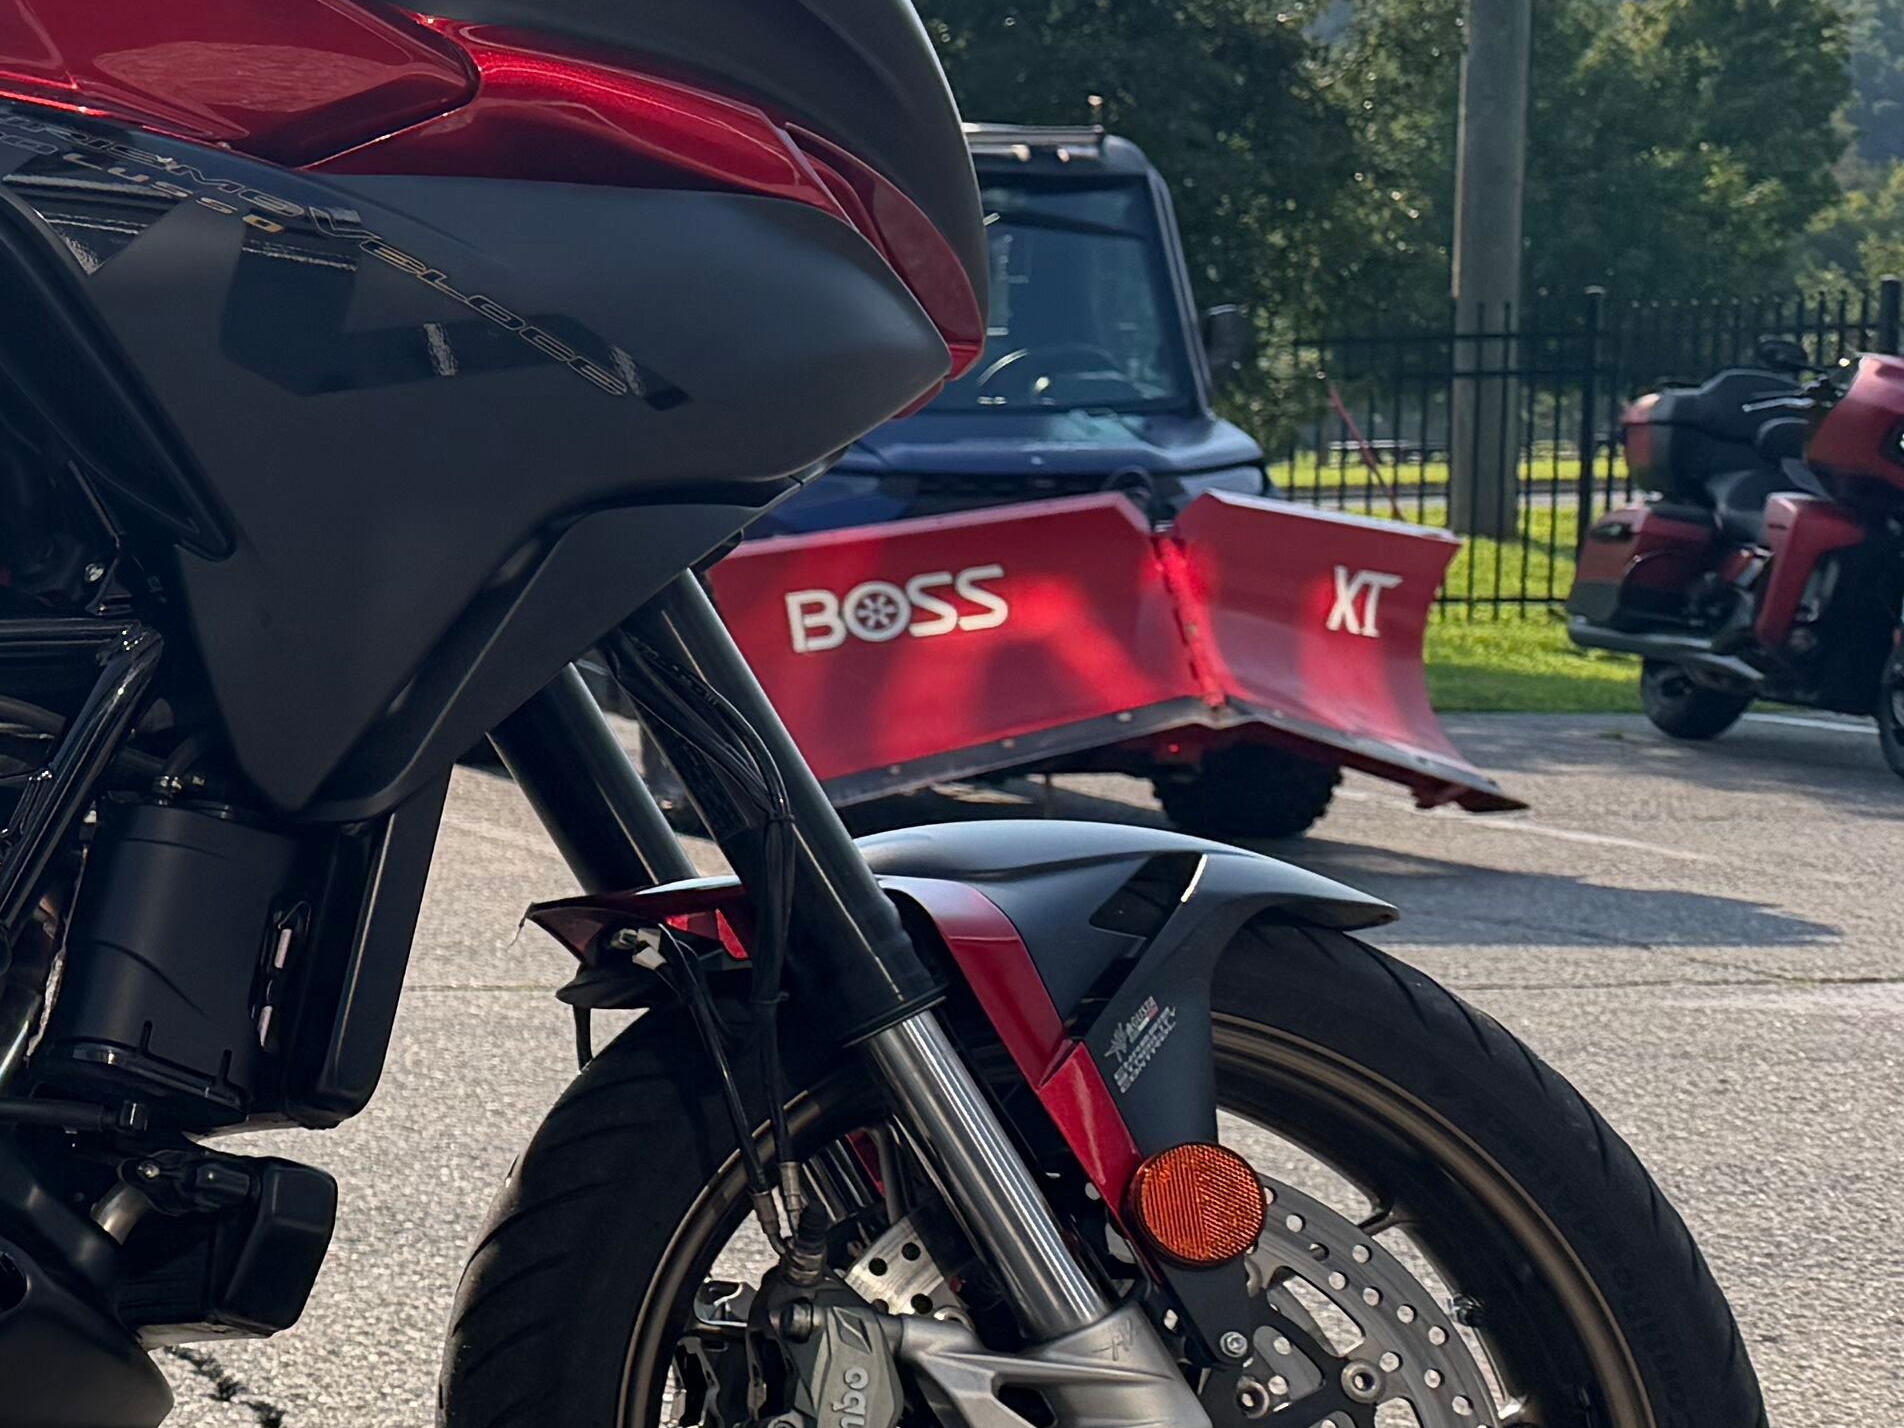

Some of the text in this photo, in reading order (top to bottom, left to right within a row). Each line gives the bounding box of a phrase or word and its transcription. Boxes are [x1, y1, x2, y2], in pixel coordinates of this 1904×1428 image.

[62, 152, 286, 234] LUSSO
[784, 563, 1010, 655] BOSS
[1325, 565, 1403, 639] XT
